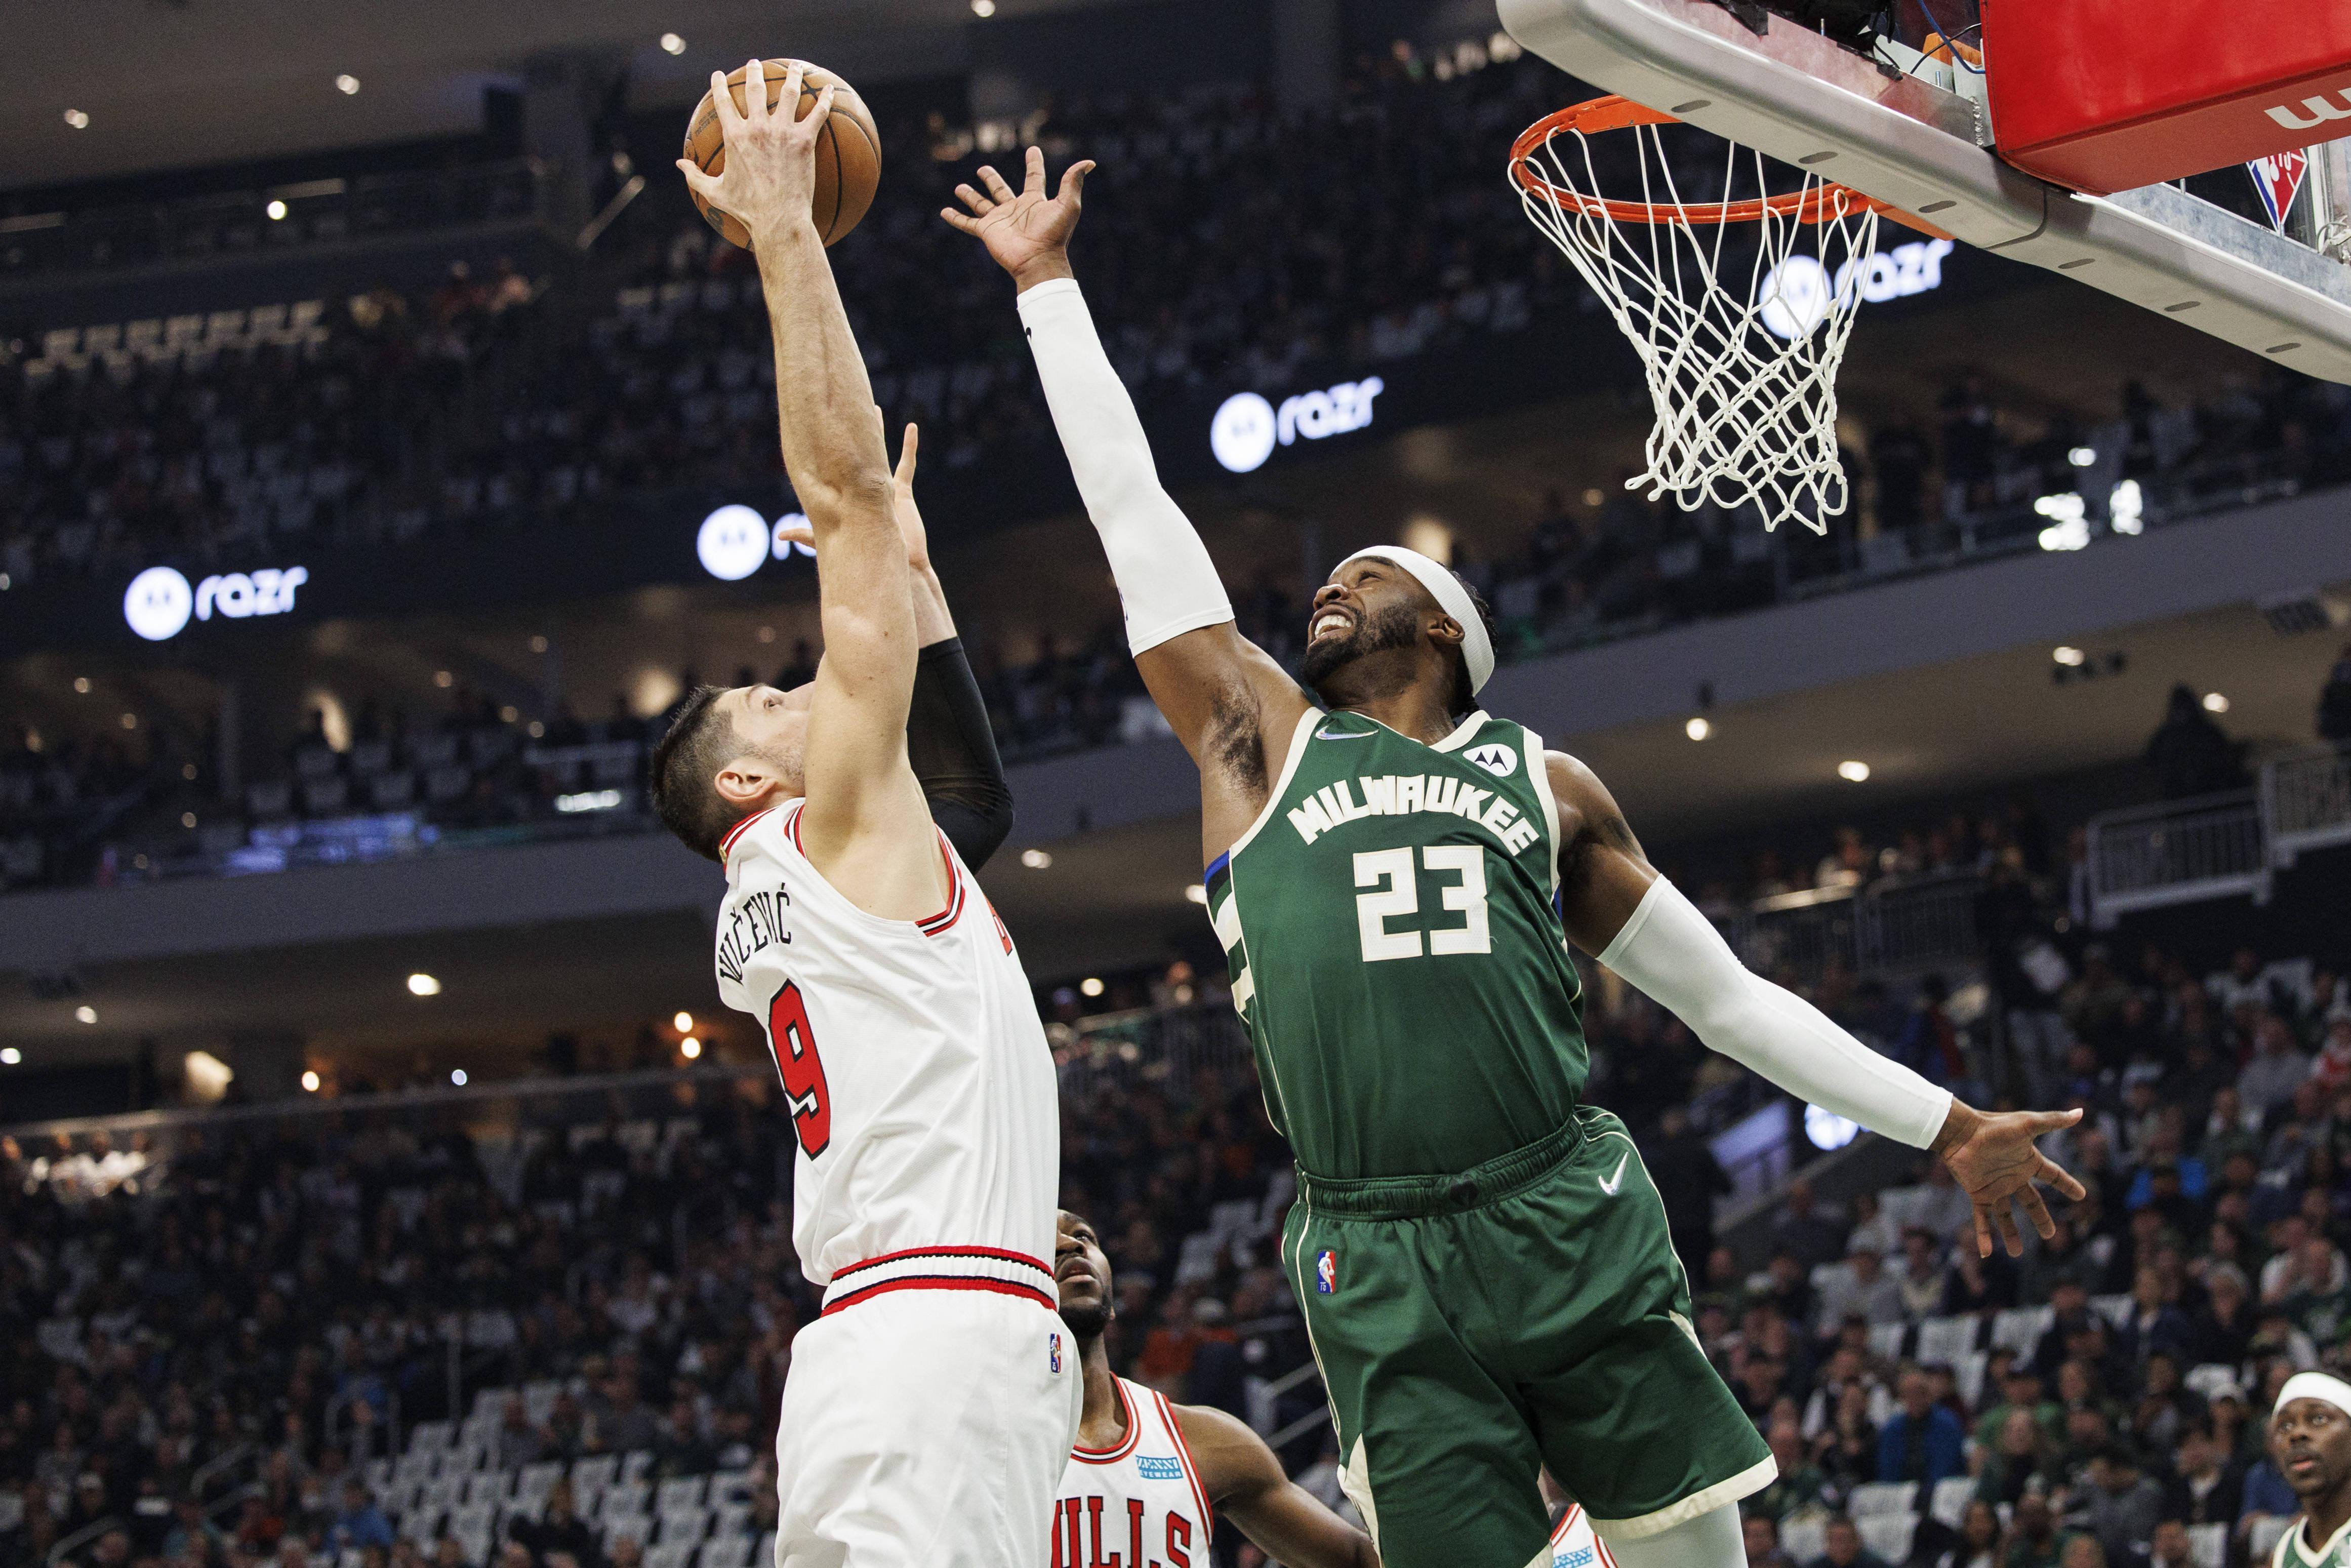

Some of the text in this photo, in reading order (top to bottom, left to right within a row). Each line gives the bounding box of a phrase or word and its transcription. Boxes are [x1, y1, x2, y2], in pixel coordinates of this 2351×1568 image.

[1278, 375, 1385, 446] razr
[194, 566, 309, 621] razr
[1287, 774, 1539, 856] MILWAUKEE
[1353, 845, 1491, 962] 23
[768, 978, 831, 1161] 9
[1320, 1281, 1327, 1292] 75
[1140, 1469, 1182, 1477] EYEWEAR
[1050, 1495, 1192, 1568] ULLS
